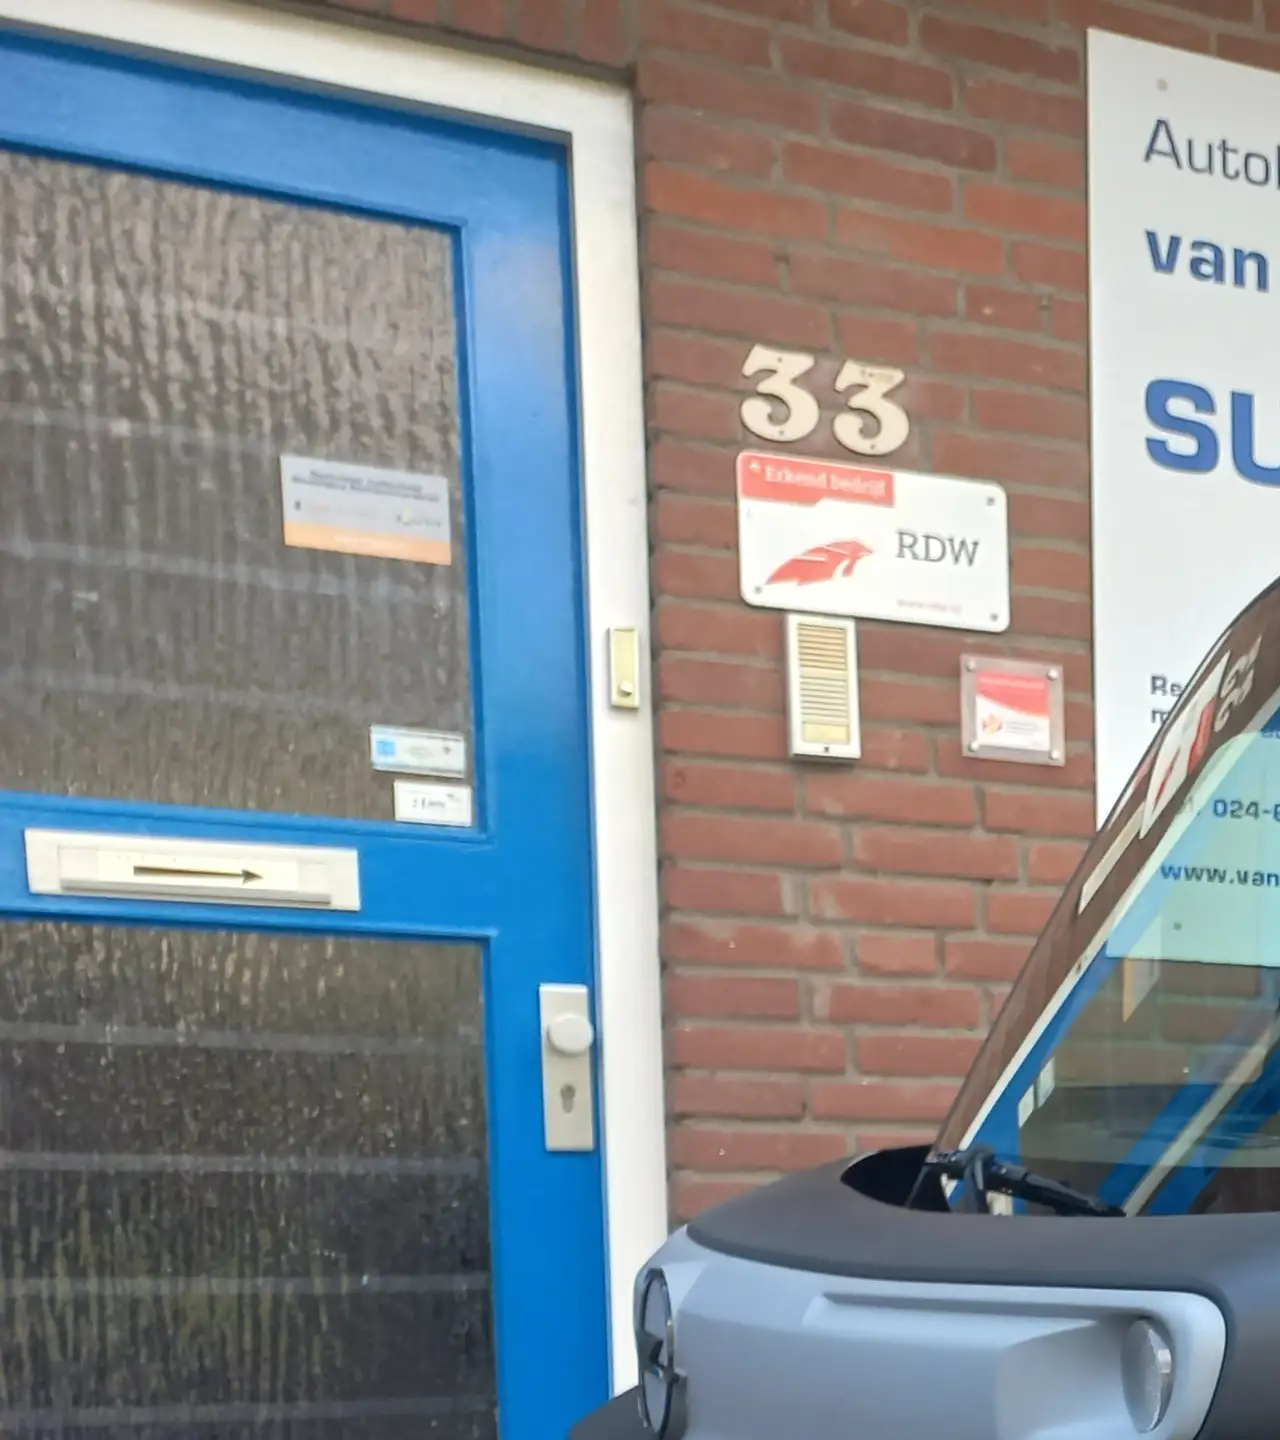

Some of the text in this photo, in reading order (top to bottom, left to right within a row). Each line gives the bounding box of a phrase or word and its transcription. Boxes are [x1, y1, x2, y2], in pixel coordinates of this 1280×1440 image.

[1144, 229, 1270, 293] van
[740, 343, 910, 457] 33
[895, 530, 980, 568] RDW
